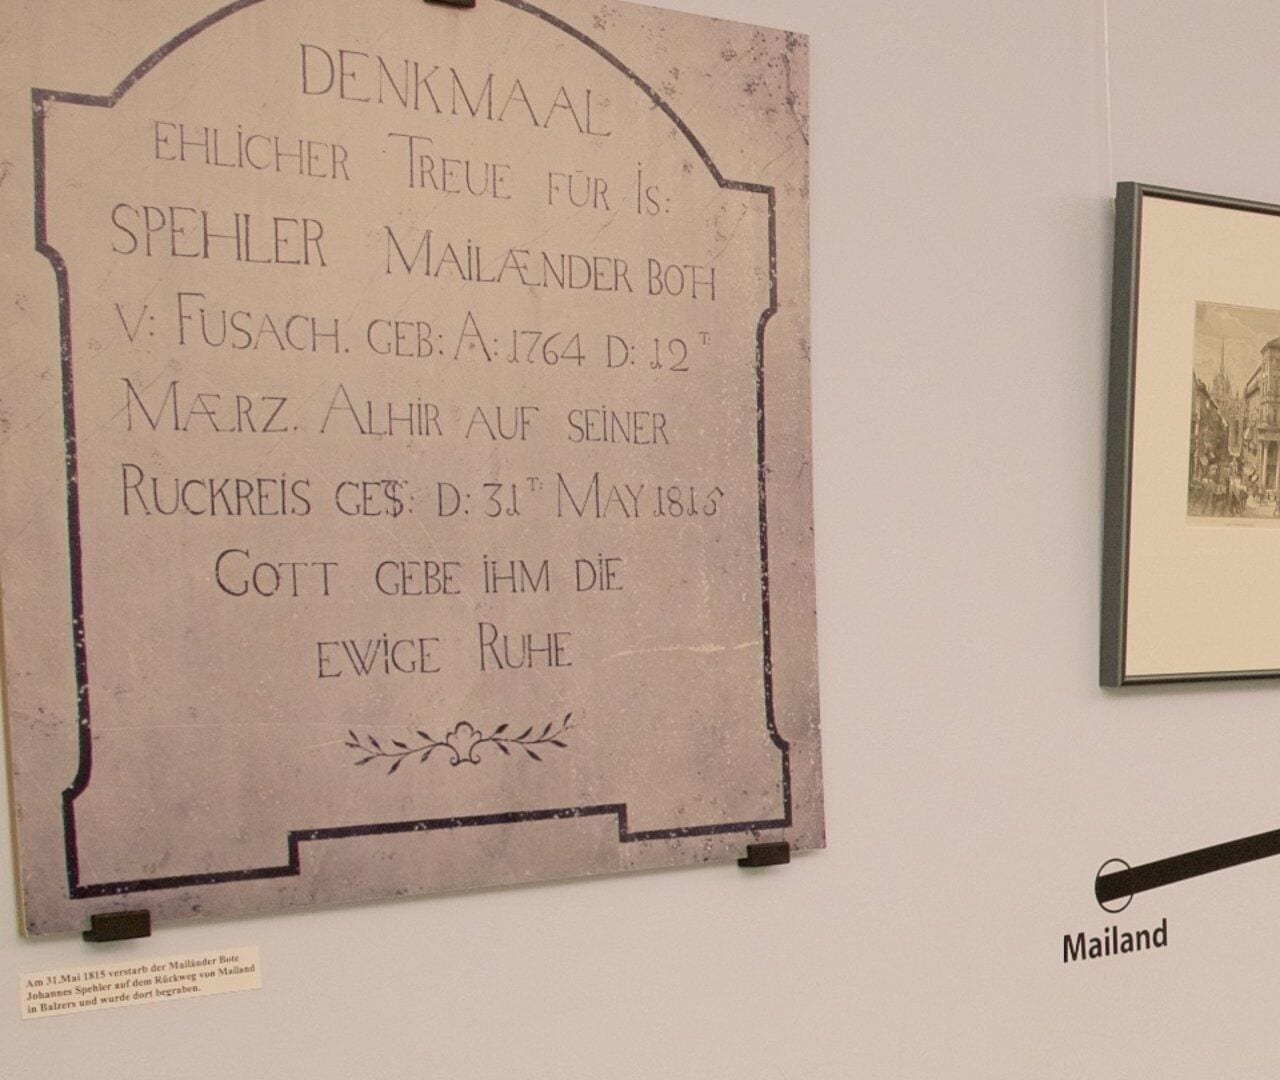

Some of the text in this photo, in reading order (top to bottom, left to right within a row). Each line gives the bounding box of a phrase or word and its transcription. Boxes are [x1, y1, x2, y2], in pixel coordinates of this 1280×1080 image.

[300, 43, 612, 137] DENKMAAL
[111, 203, 327, 267] SPEHLER
[647, 258, 716, 301] BOTH
[507, 329, 586, 367] 1764
[465, 405, 539, 441] AUF
[557, 472, 645, 518] MAY
[215, 549, 338, 597] GOTT
[375, 560, 461, 596] GEBE
[478, 621, 573, 672] RUHE
[1062, 918, 1169, 964] Mailand
[26, 977, 44, 989] Am
[84, 970, 106, 980] 1815
[108, 964, 149, 978] verstarb
[150, 962, 167, 974] der
[169, 956, 217, 971] Mailänder
[219, 953, 239, 964] Bote
[26, 986, 73, 1001] Johannes
[115, 979, 130, 991] auf
[132, 975, 153, 987] dem
[154, 969, 197, 986] Rückweg
[199, 970, 216, 980] von
[218, 963, 256, 978] Mailand
[27, 1003, 37, 1014] in
[40, 1000, 77, 1013] Balzers
[79, 996, 97, 1007] und
[100, 992, 131, 1004] wurde
[133, 988, 153, 1001] dort
